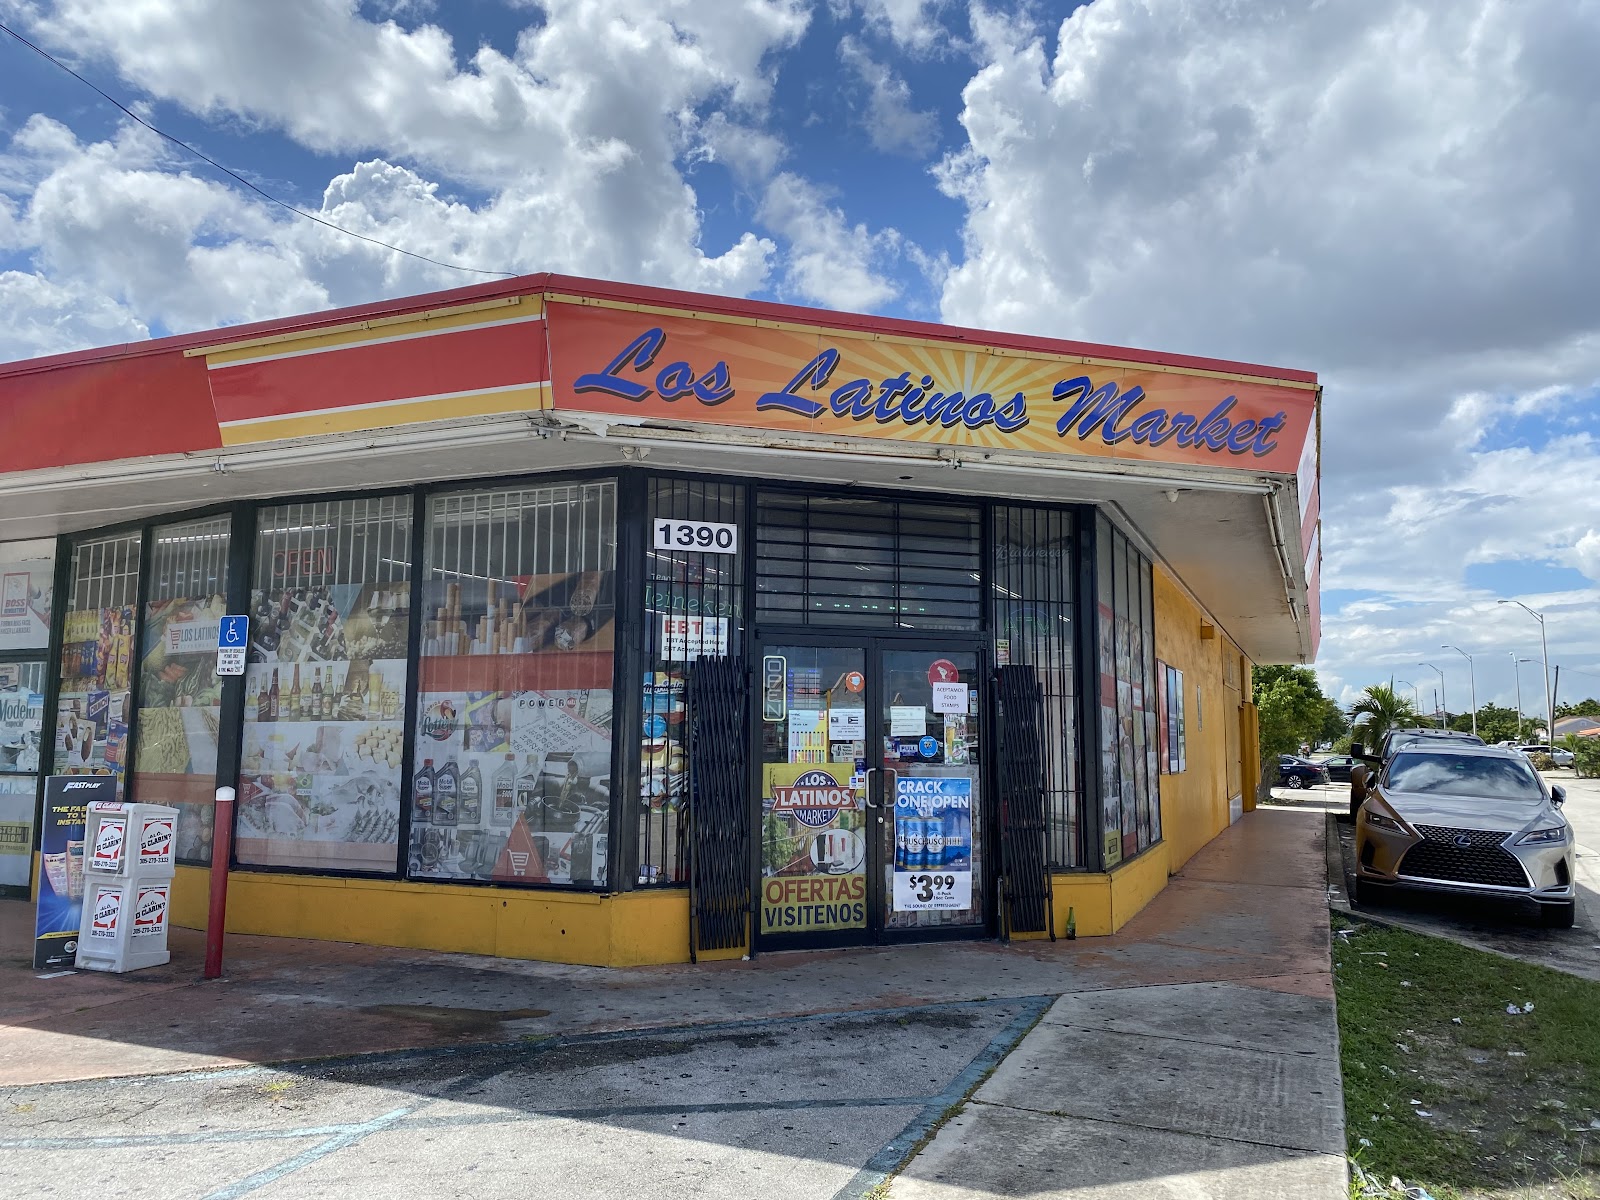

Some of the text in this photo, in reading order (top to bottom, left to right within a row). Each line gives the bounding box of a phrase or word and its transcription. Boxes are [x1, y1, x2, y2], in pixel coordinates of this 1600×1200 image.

[574, 327, 1288, 458] Los Latinos Market
[659, 523, 733, 549] 1390
[273, 548, 332, 577] OPEN
[181, 628, 193, 642] LOS
[665, 620, 702, 635] EBT
[767, 660, 782, 717] OPEN
[805, 773, 827, 786] LOS
[897, 780, 944, 794] CRACK
[780, 789, 851, 807] LATINOS
[897, 795, 969, 809] ONE OPEN
[799, 808, 832, 825] MARKET
[765, 876, 865, 905] OFERTAS
[764, 902, 864, 928] VISITENOS
